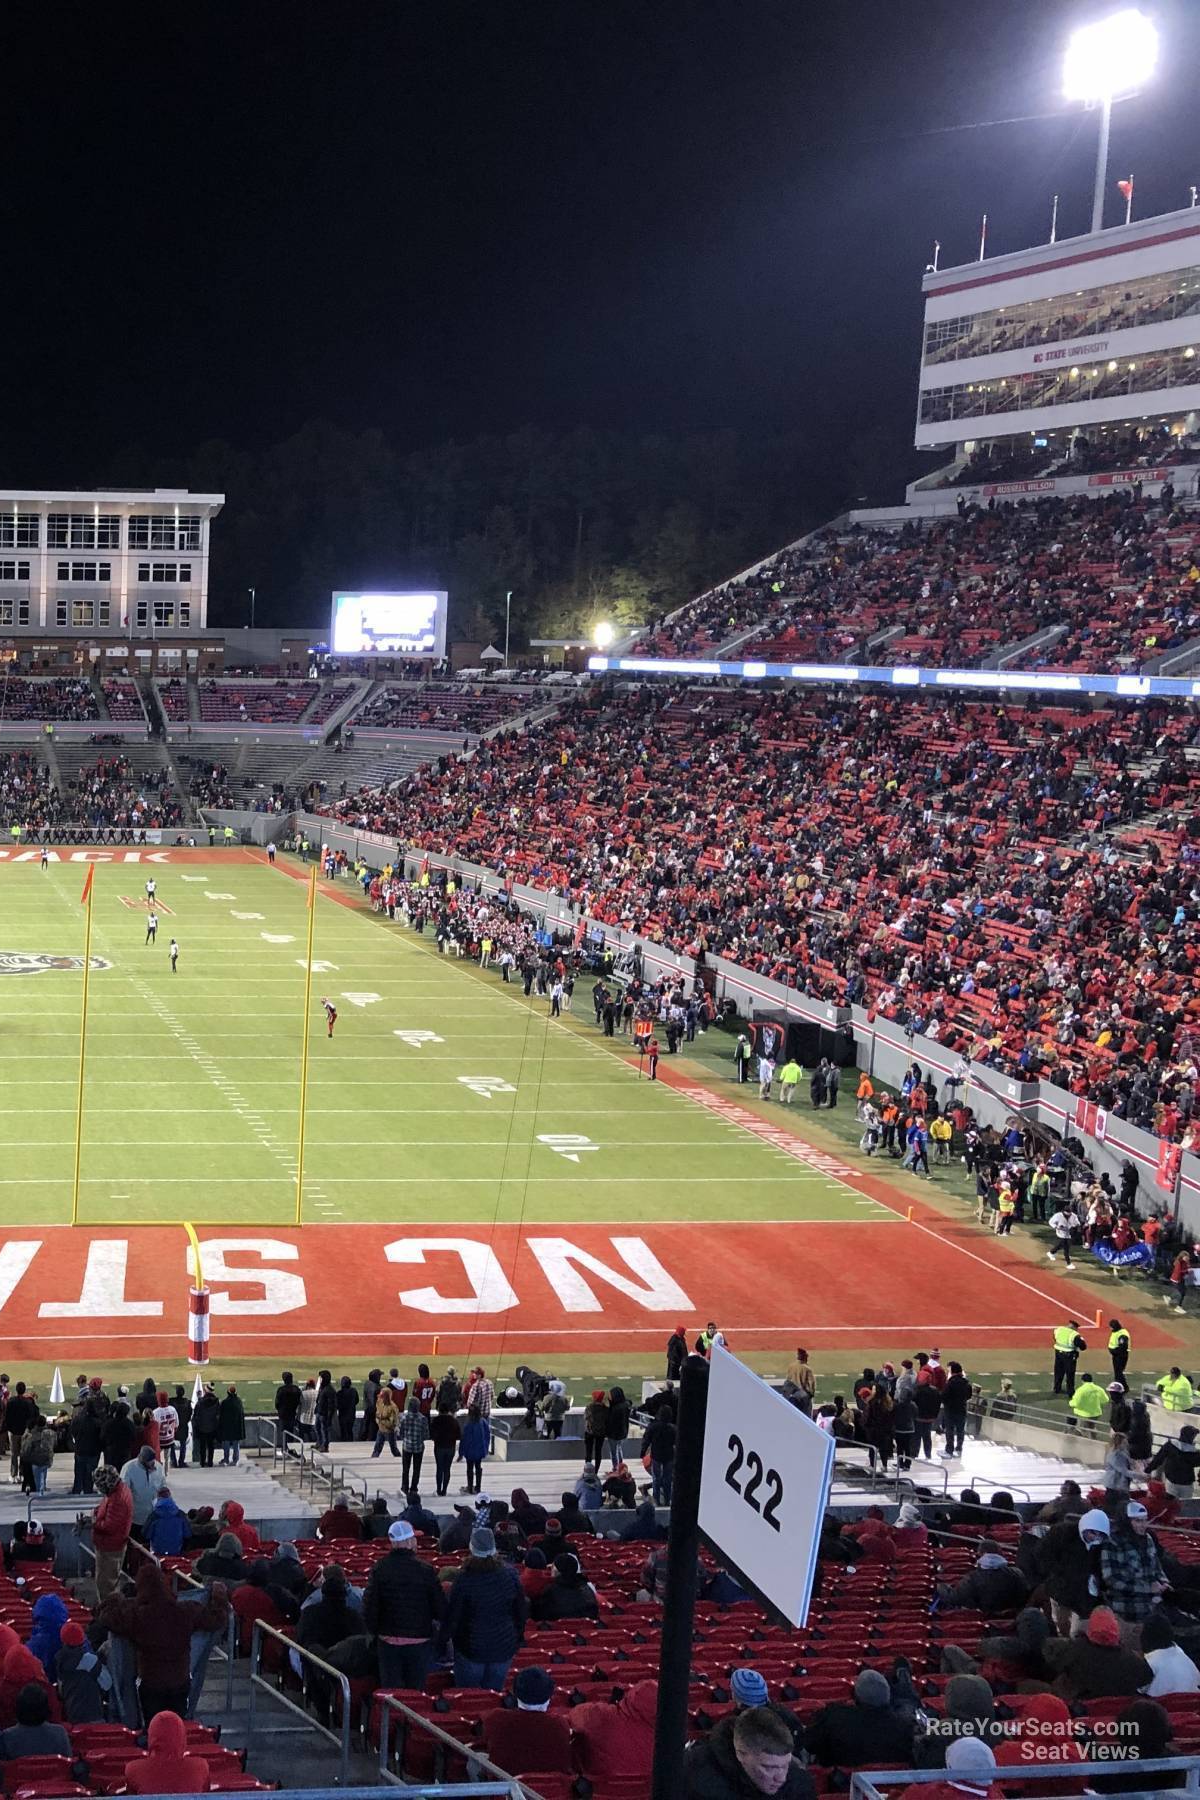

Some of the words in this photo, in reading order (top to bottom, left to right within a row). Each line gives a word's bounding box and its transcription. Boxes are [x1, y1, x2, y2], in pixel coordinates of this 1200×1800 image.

[1045, 349, 1067, 361] STATE
[1068, 342, 1109, 357] UNIVERSITY
[1028, 481, 1054, 493] WILSON
[536, 1134, 600, 1151] 10
[384, 1237, 696, 1314] NC
[421, 1387, 433, 1399] 87
[724, 1434, 784, 1532] 222
